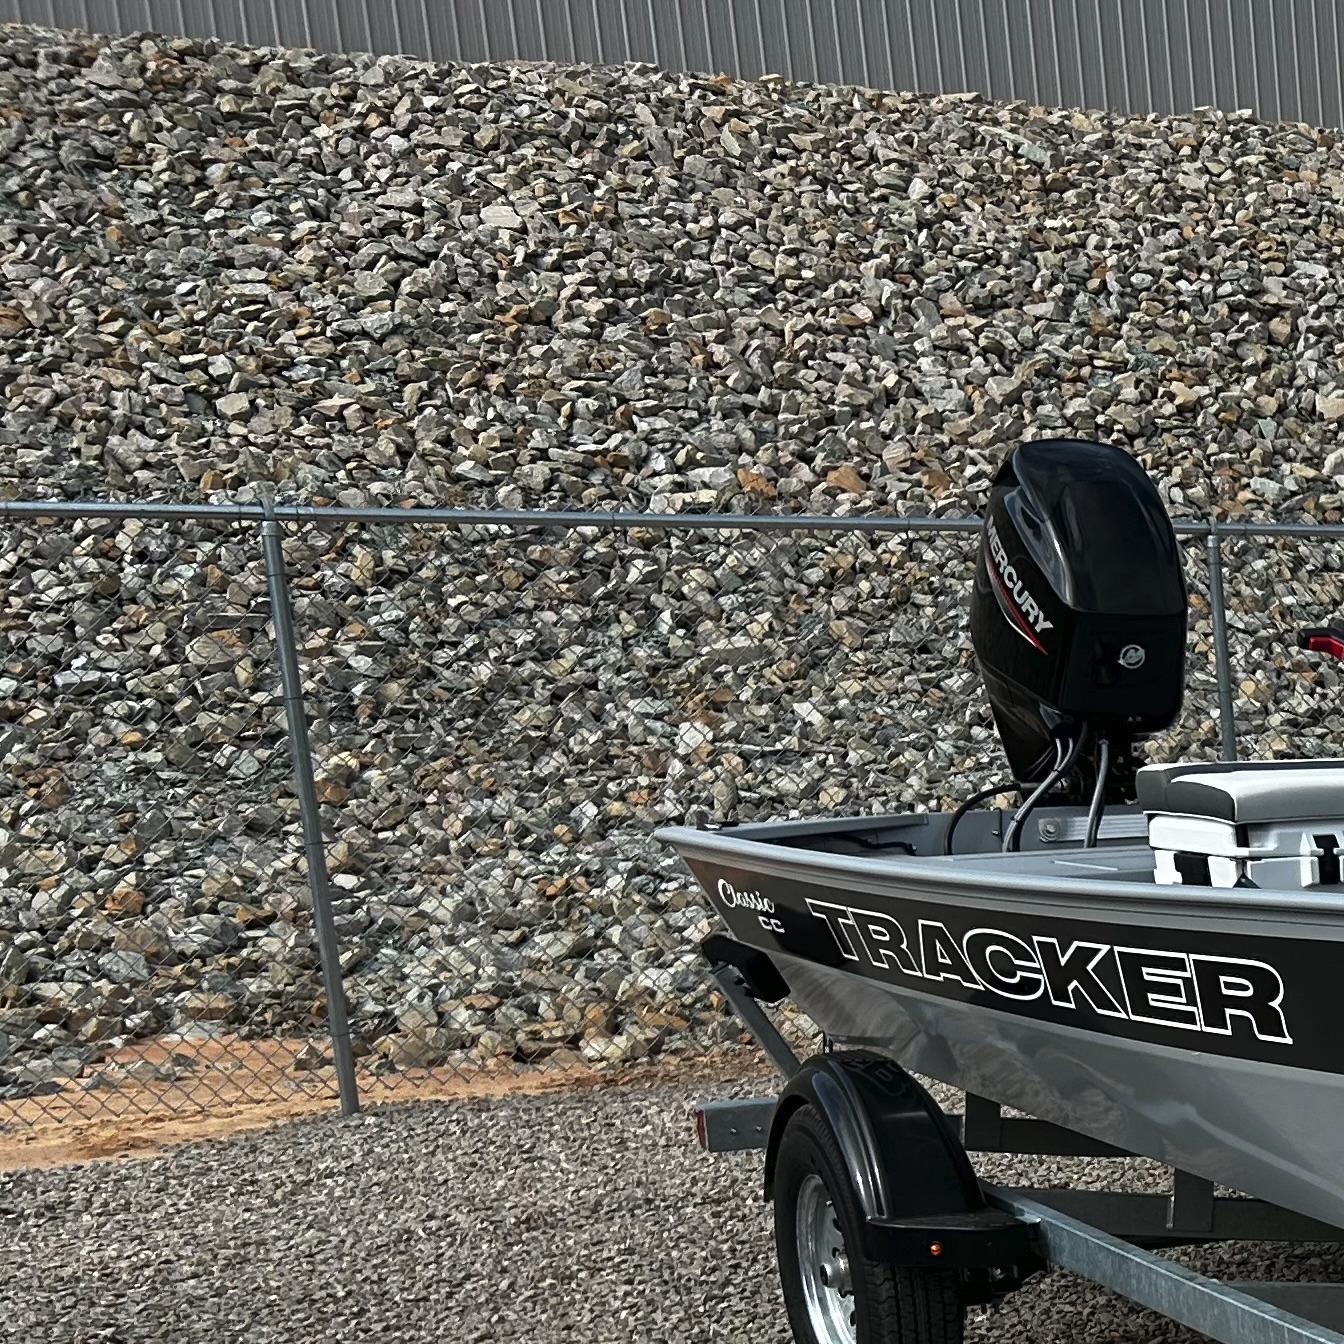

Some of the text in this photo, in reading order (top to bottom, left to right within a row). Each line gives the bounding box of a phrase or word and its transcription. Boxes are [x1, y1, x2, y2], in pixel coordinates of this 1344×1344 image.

[986, 515, 1053, 632] MERCURY
[717, 878, 775, 913] Classic
[758, 915, 785, 933] CC
[805, 897, 1294, 1045] TRACKER
